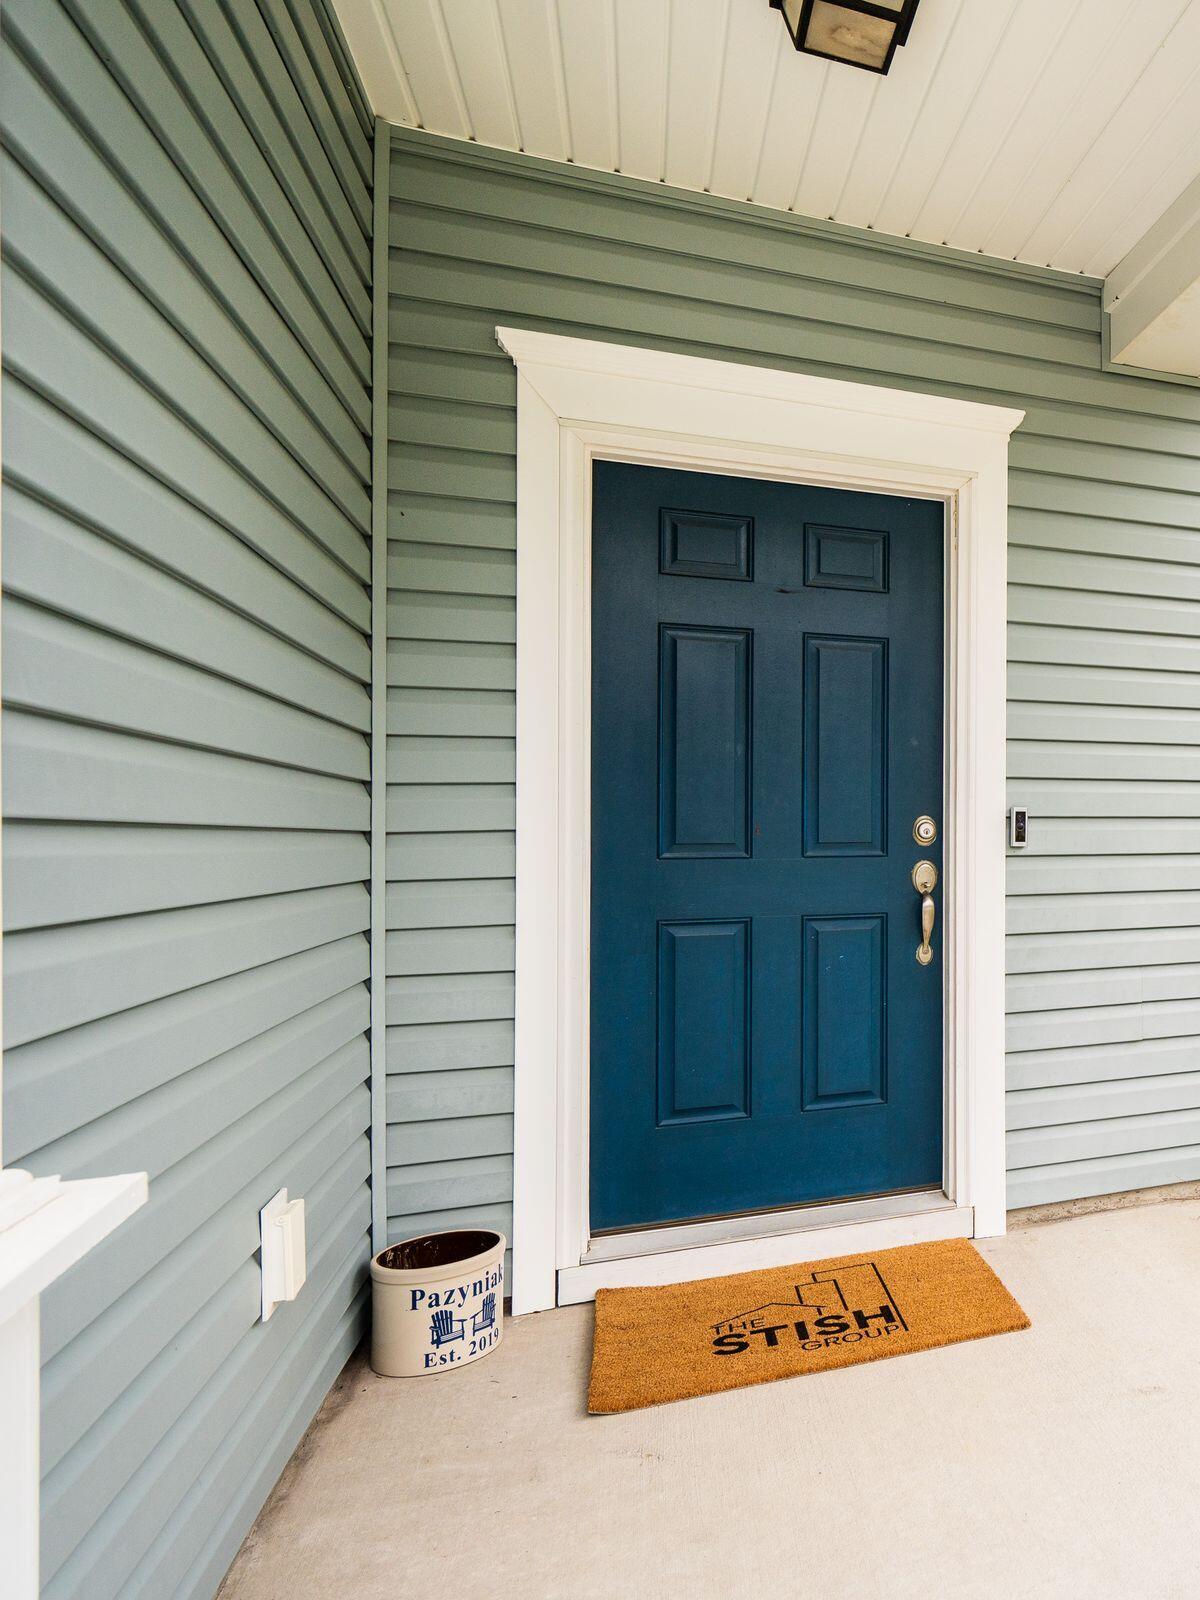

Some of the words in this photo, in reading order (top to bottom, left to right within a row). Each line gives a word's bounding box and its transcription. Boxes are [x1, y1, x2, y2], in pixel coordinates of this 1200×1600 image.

[410, 1263, 503, 1311] Pazyniak
[712, 1316, 765, 1335] THE
[712, 1305, 896, 1356] STISH
[801, 1324, 900, 1351] GROUP
[424, 1350, 461, 1368] Est.
[469, 1327, 499, 1356] 2019
